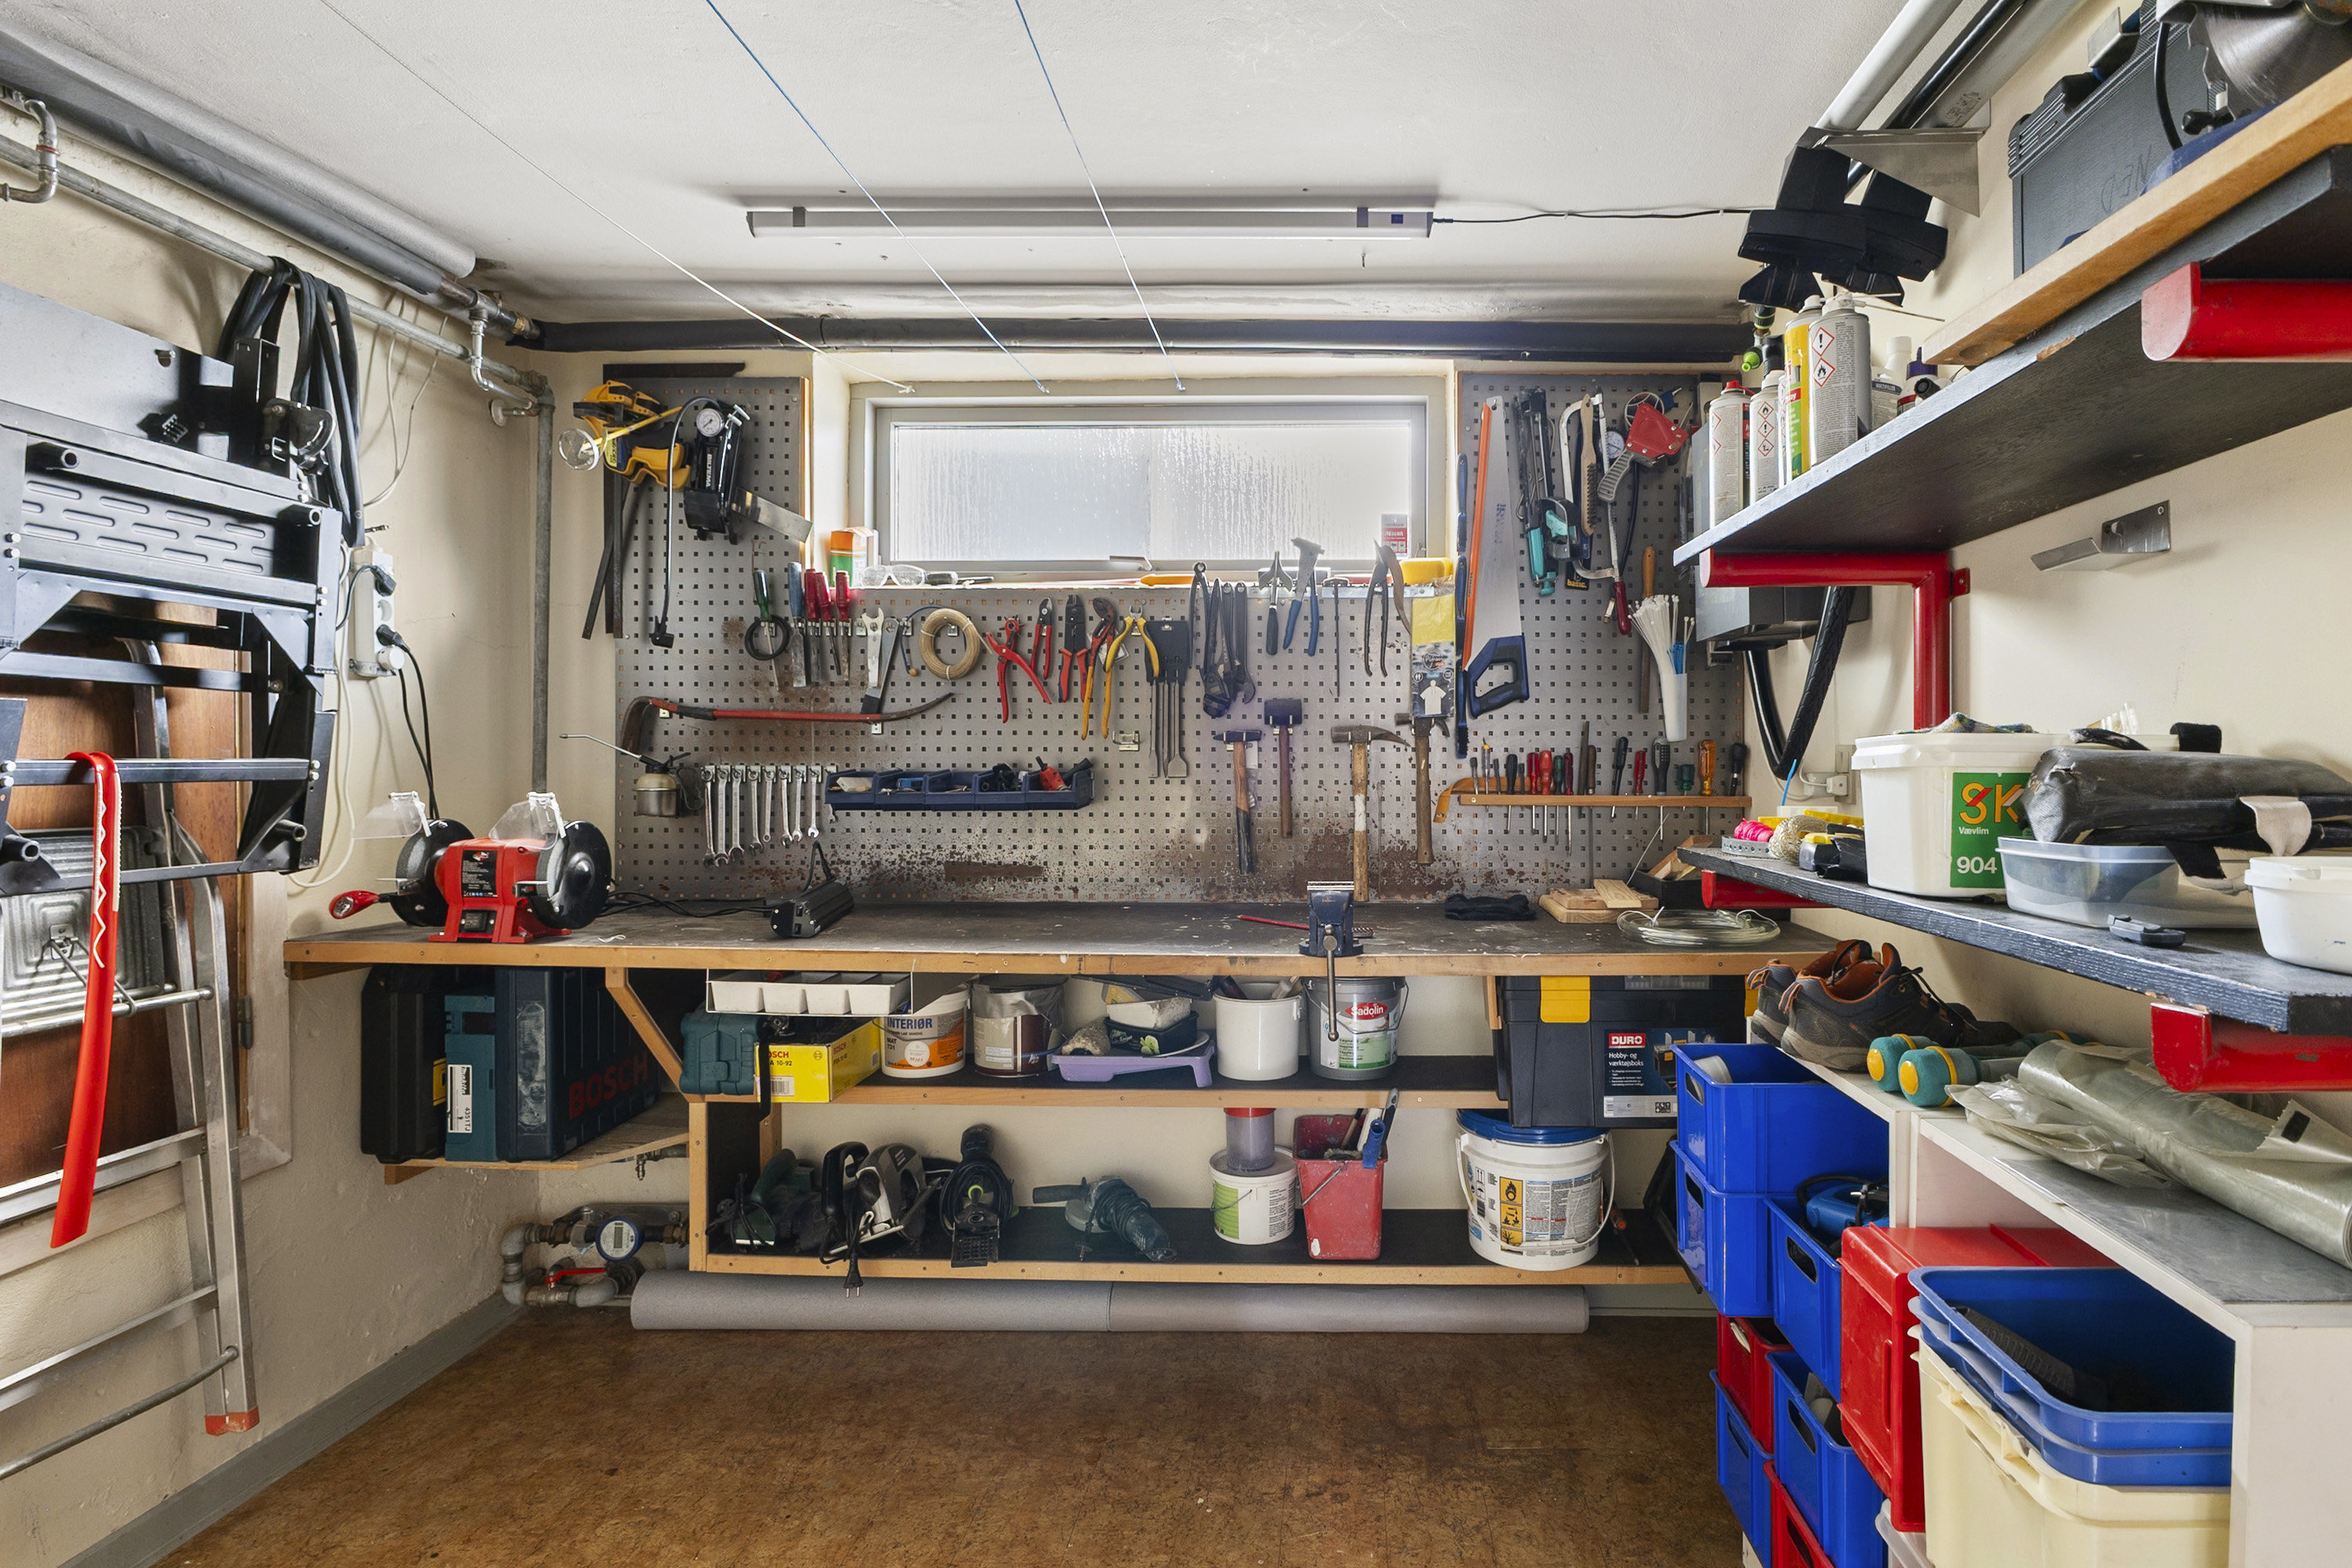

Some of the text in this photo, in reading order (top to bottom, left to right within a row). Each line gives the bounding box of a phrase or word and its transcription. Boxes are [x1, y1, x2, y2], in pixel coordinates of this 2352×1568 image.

[1958, 826, 1989, 835] Vævlim
[1956, 856, 1998, 874] 904
[1351, 1005, 1384, 1016] Sadolin
[887, 1017, 933, 1029] INTERIØR
[1611, 1036, 1643, 1045] DURO
[569, 1051, 648, 1120] BOSCH
